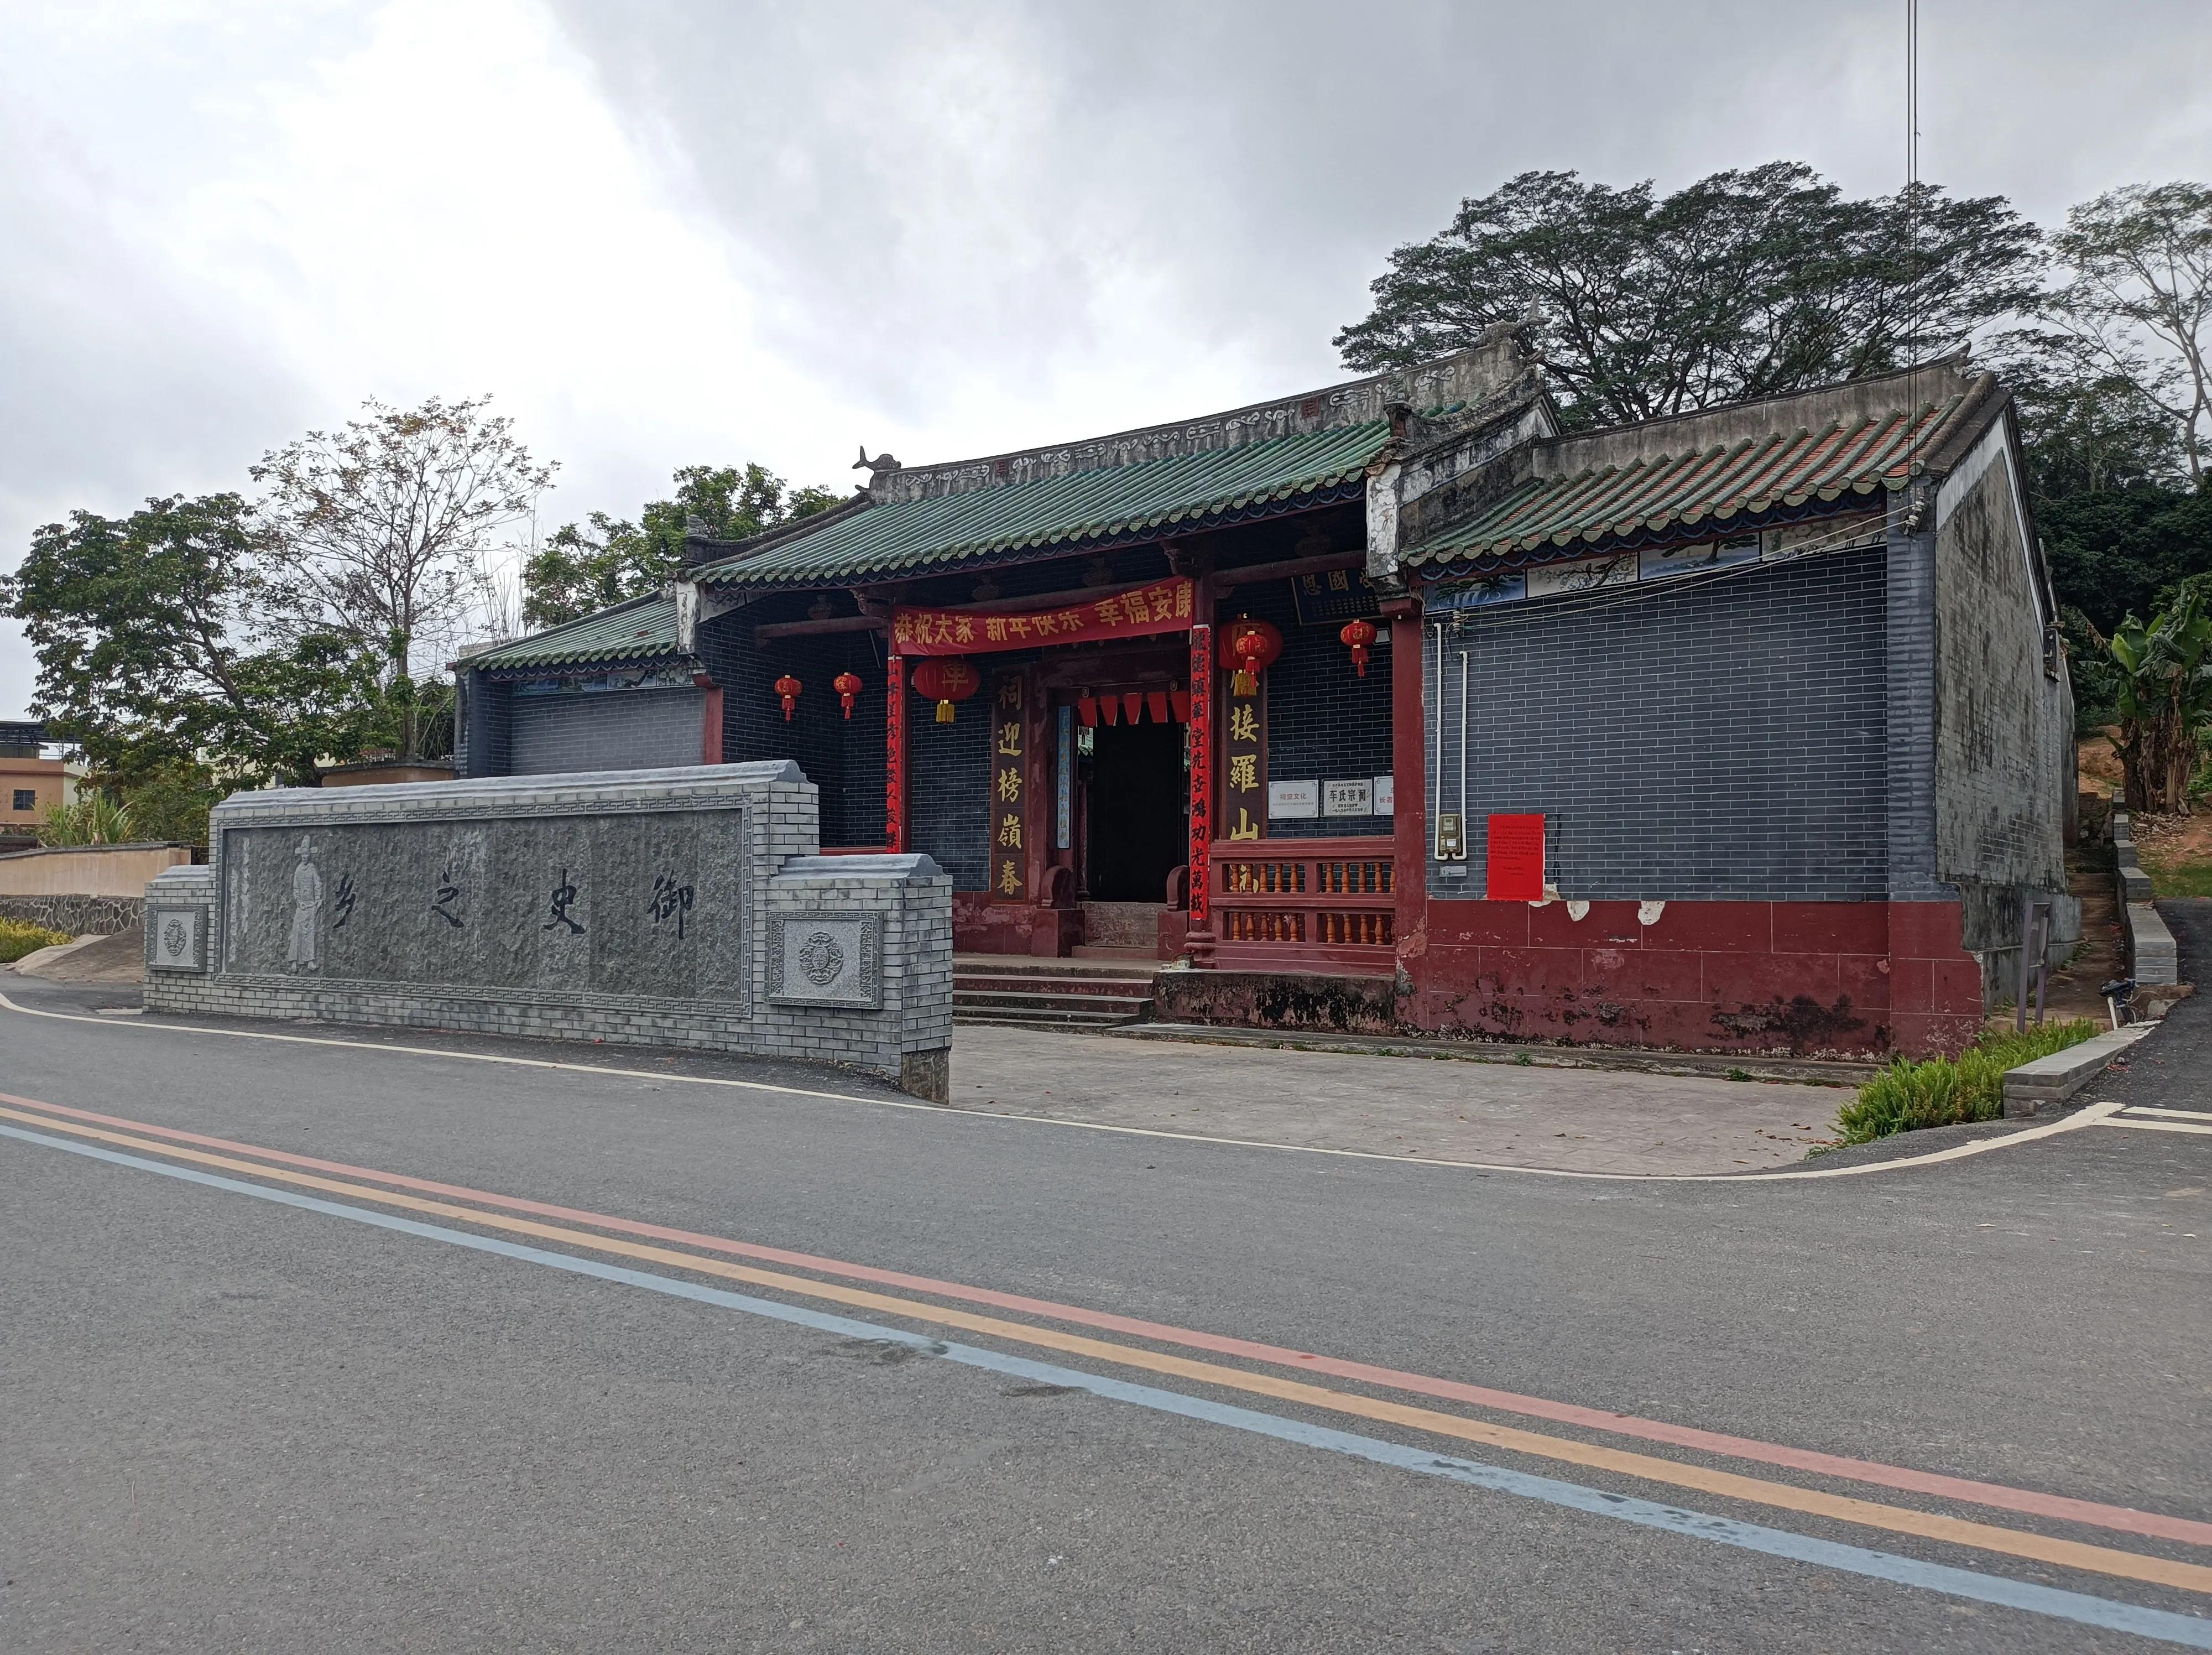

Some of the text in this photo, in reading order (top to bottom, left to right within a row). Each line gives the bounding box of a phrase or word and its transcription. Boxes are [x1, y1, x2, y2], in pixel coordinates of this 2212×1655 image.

[894, 612, 974, 644] 恭祝大家
[1094, 581, 1192, 627] 幸福安康
[998, 675, 1023, 895] 祠迎榜嶺春
[332, 868, 694, 940] 御史之乡
